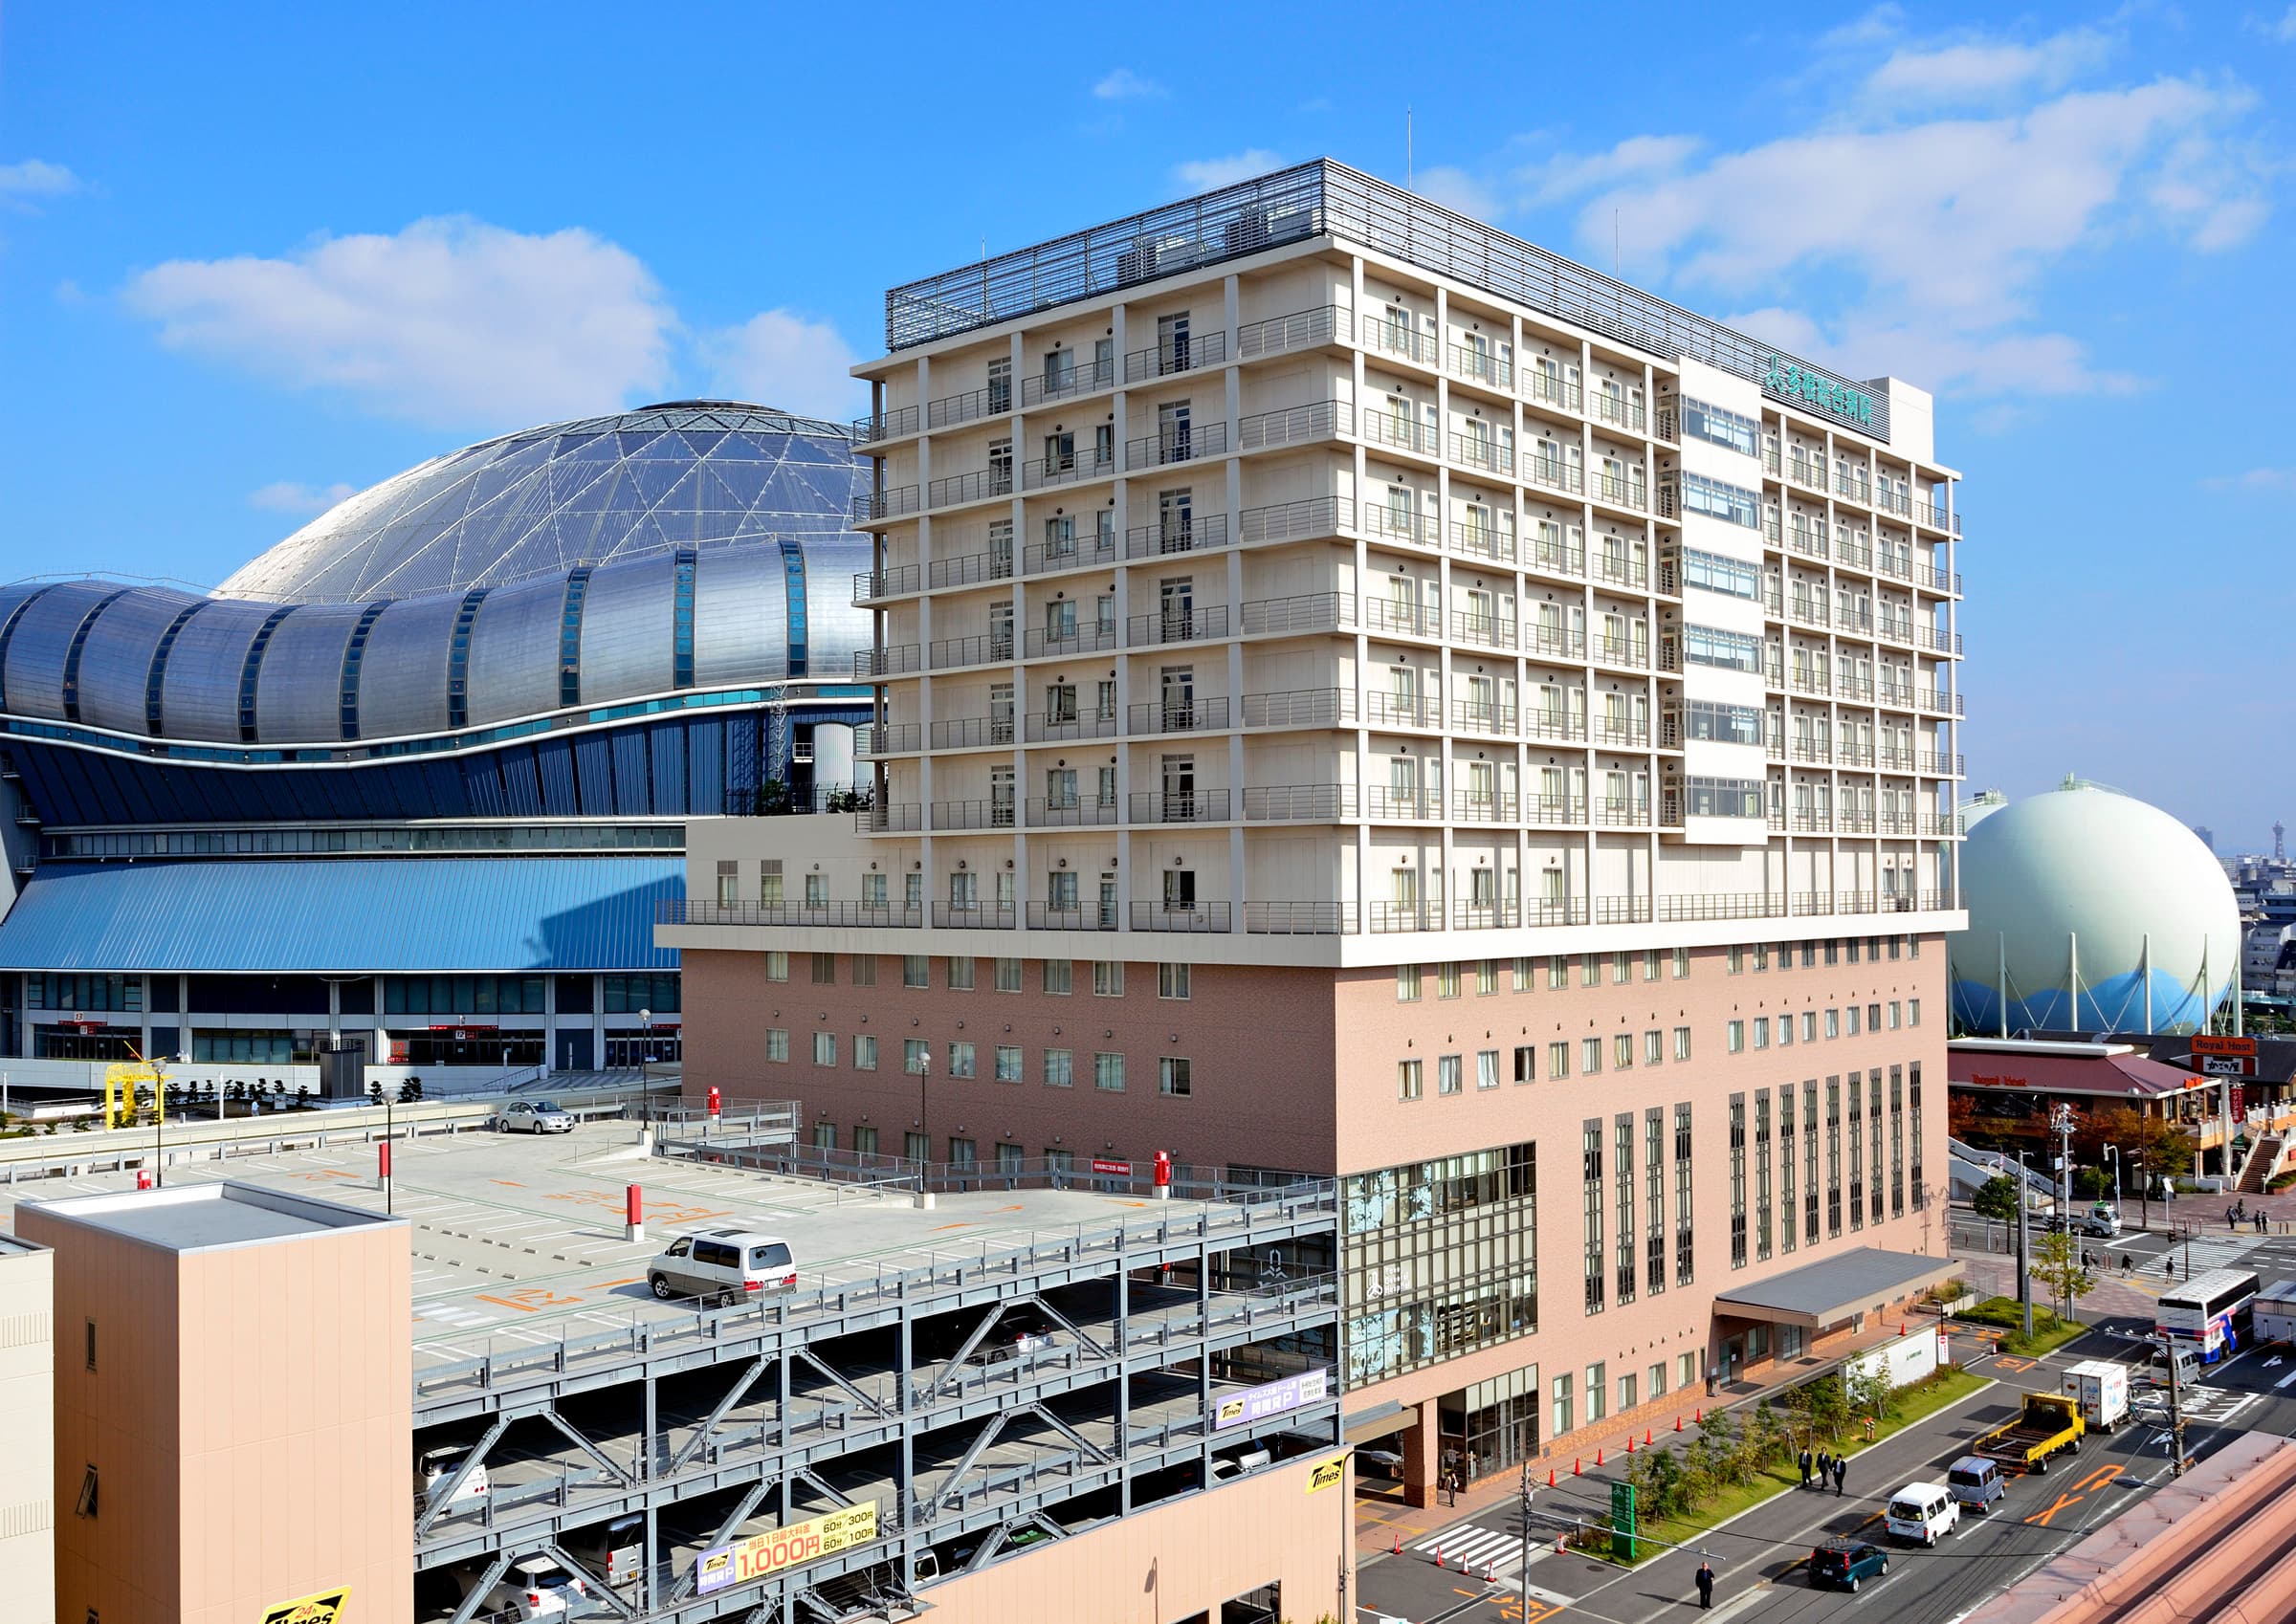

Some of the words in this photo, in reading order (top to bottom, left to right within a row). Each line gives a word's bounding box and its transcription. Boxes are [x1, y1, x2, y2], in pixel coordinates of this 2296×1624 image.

[391, 1042, 406, 1056] 12
[2196, 1040, 2224, 1051] Royal
[2227, 1041, 2251, 1051] Host
[1313, 1470, 1340, 1488] Times
[740, 1534, 820, 1577] 1,000円
